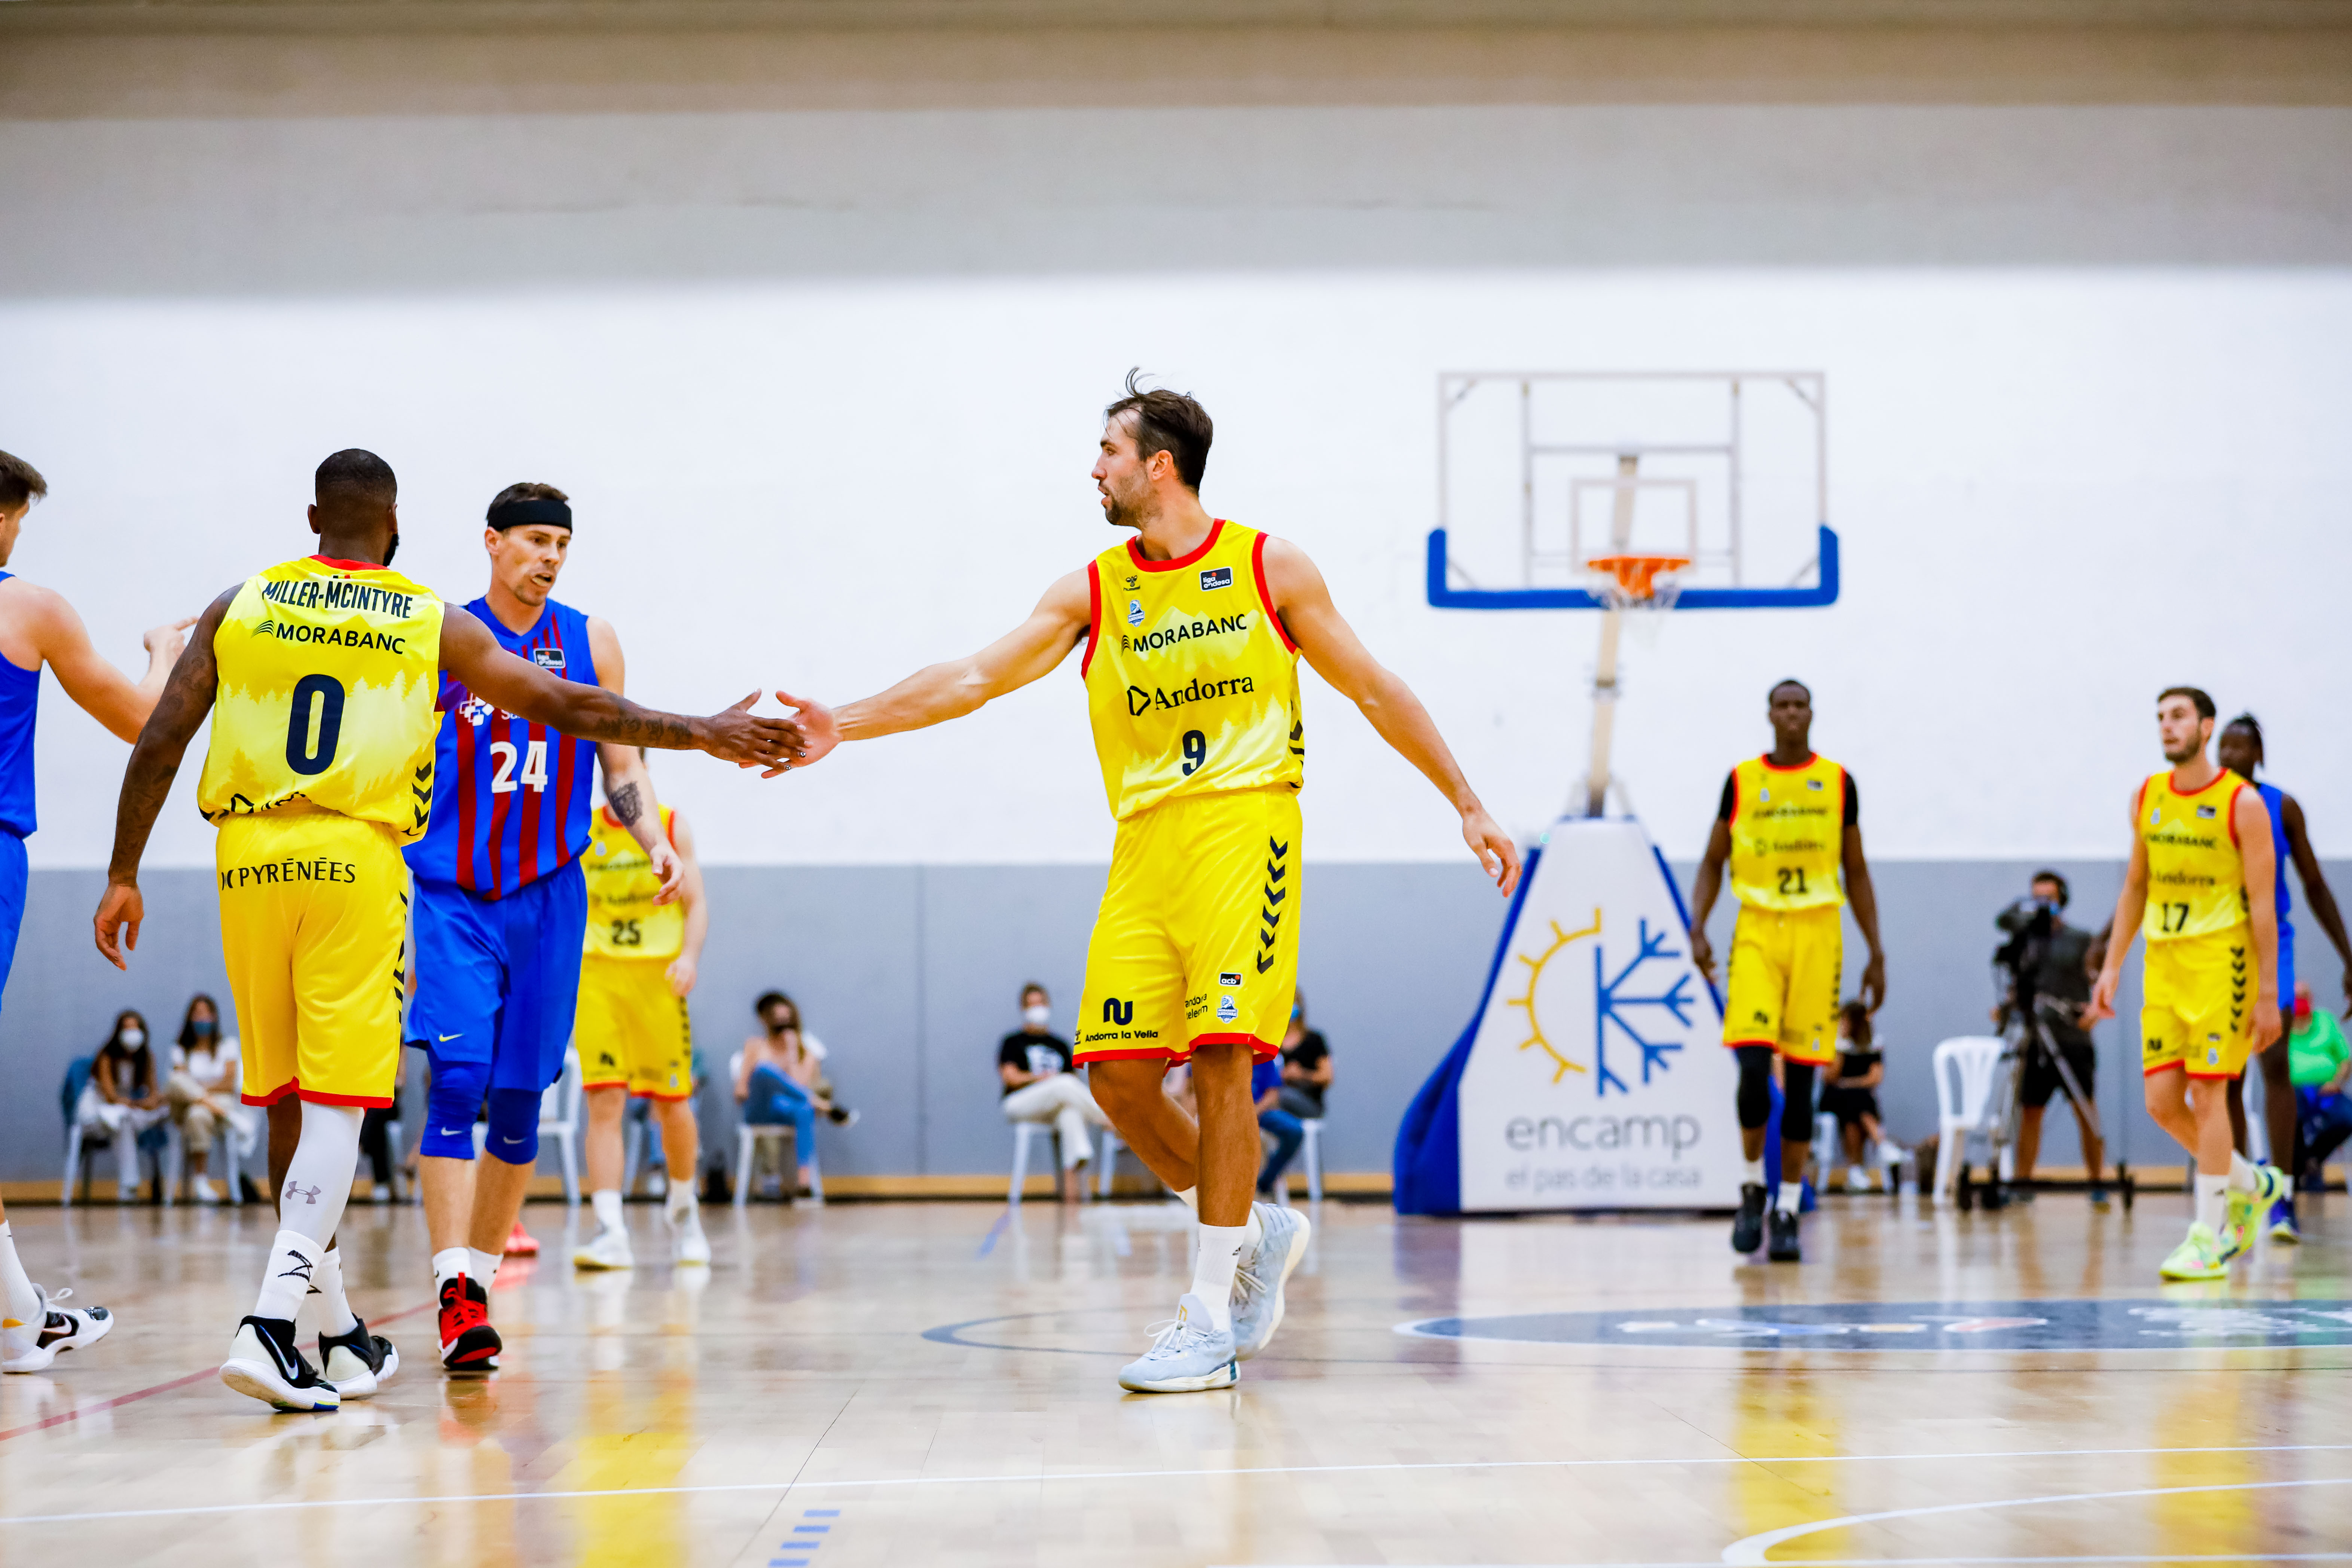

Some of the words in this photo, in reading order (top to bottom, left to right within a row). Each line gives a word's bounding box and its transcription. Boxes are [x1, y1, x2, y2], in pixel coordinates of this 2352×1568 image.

[1204, 579, 1230, 588] endesa
[276, 623, 406, 655] MORABANC
[1133, 614, 1247, 652] MORABANC
[1155, 676, 1254, 710] Andorra
[285, 674, 345, 776] 0
[490, 740, 548, 794] 24
[1182, 730, 1207, 776] 9
[1777, 866, 1808, 895] 21
[611, 918, 641, 947] 25
[2162, 901, 2190, 933] 17
[1085, 1033, 1118, 1042] Andorra
[1505, 1114, 1702, 1162] encamp
